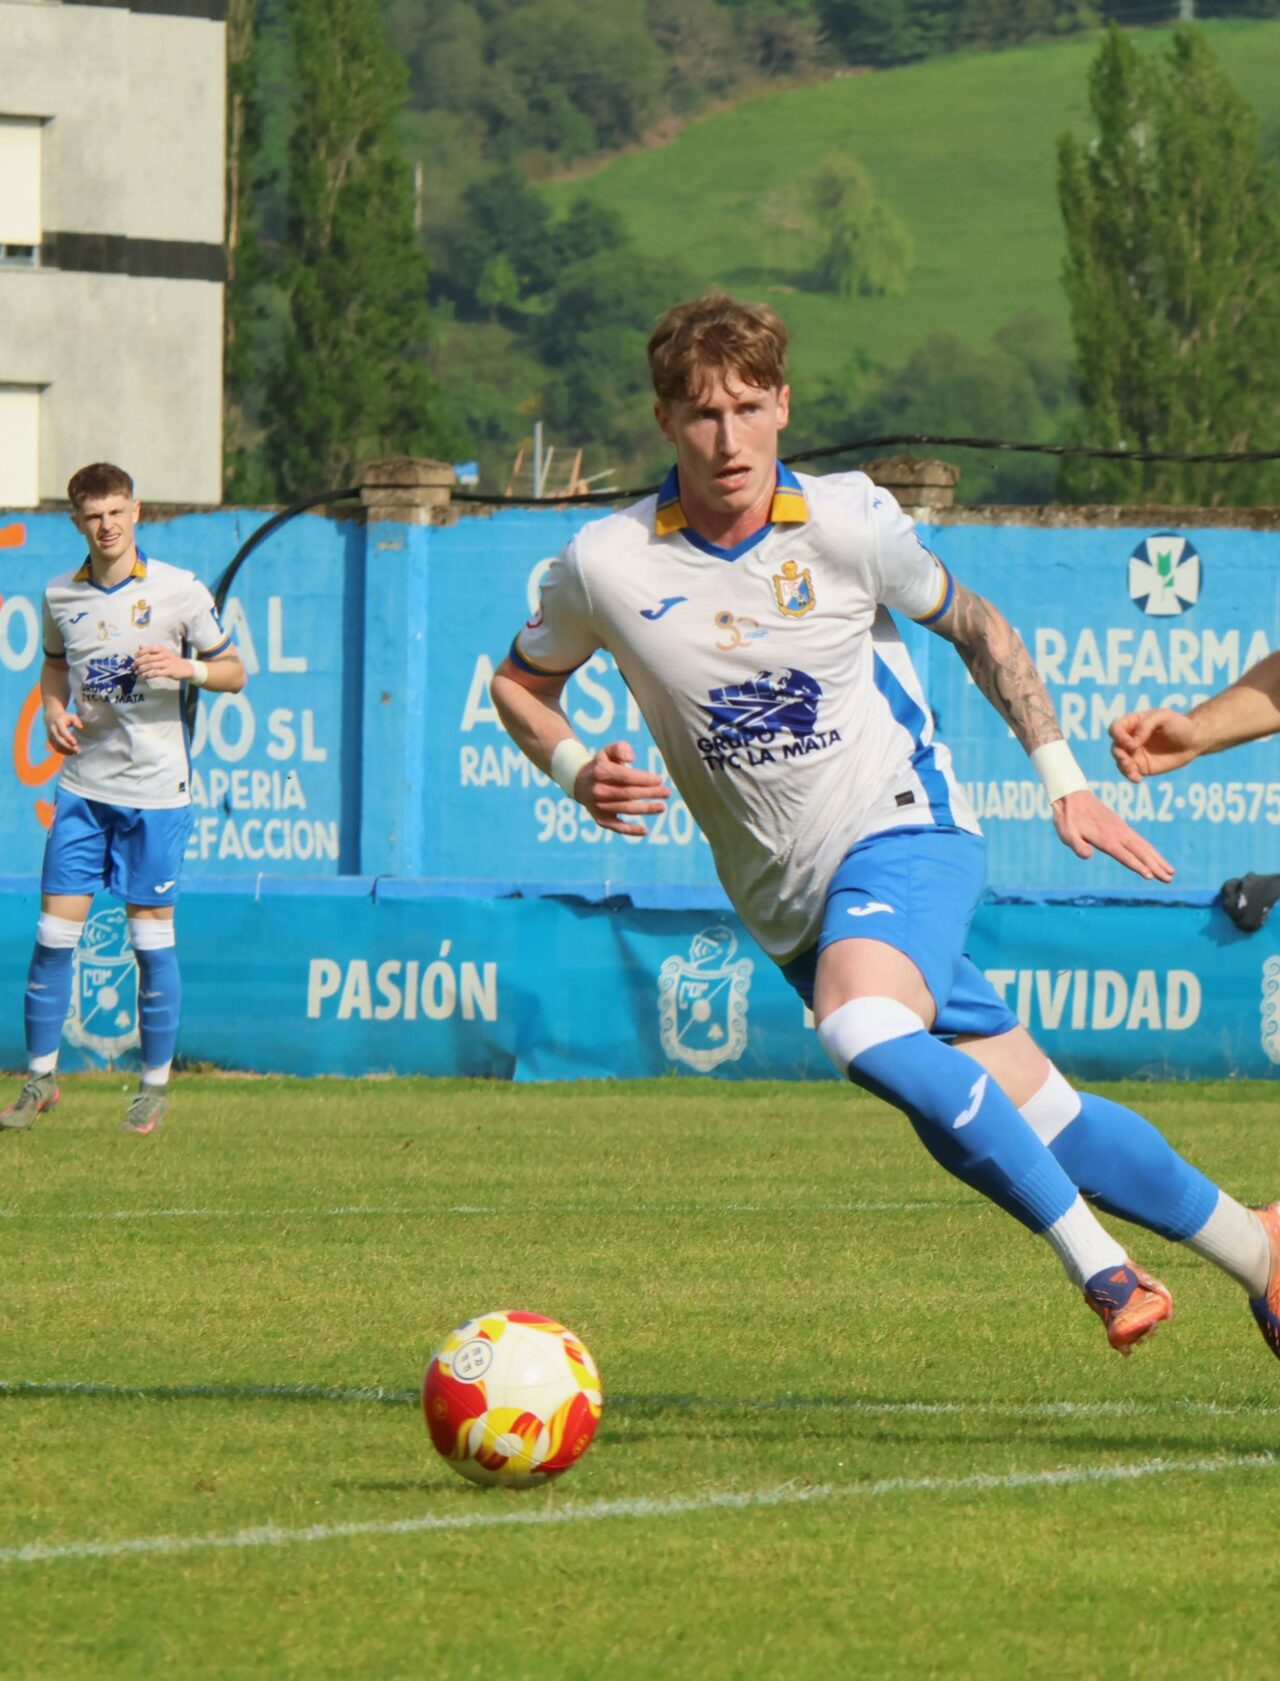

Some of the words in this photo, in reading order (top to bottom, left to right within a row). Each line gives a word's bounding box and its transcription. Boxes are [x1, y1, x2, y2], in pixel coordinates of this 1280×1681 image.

[266, 708, 327, 762] SL
[696, 728, 776, 754] GRUPO
[703, 752, 742, 772] TYC
[749, 747, 776, 767] LA
[782, 729, 842, 761] MATA
[191, 769, 306, 810] APERIA
[306, 938, 498, 1022] PASIÓN
